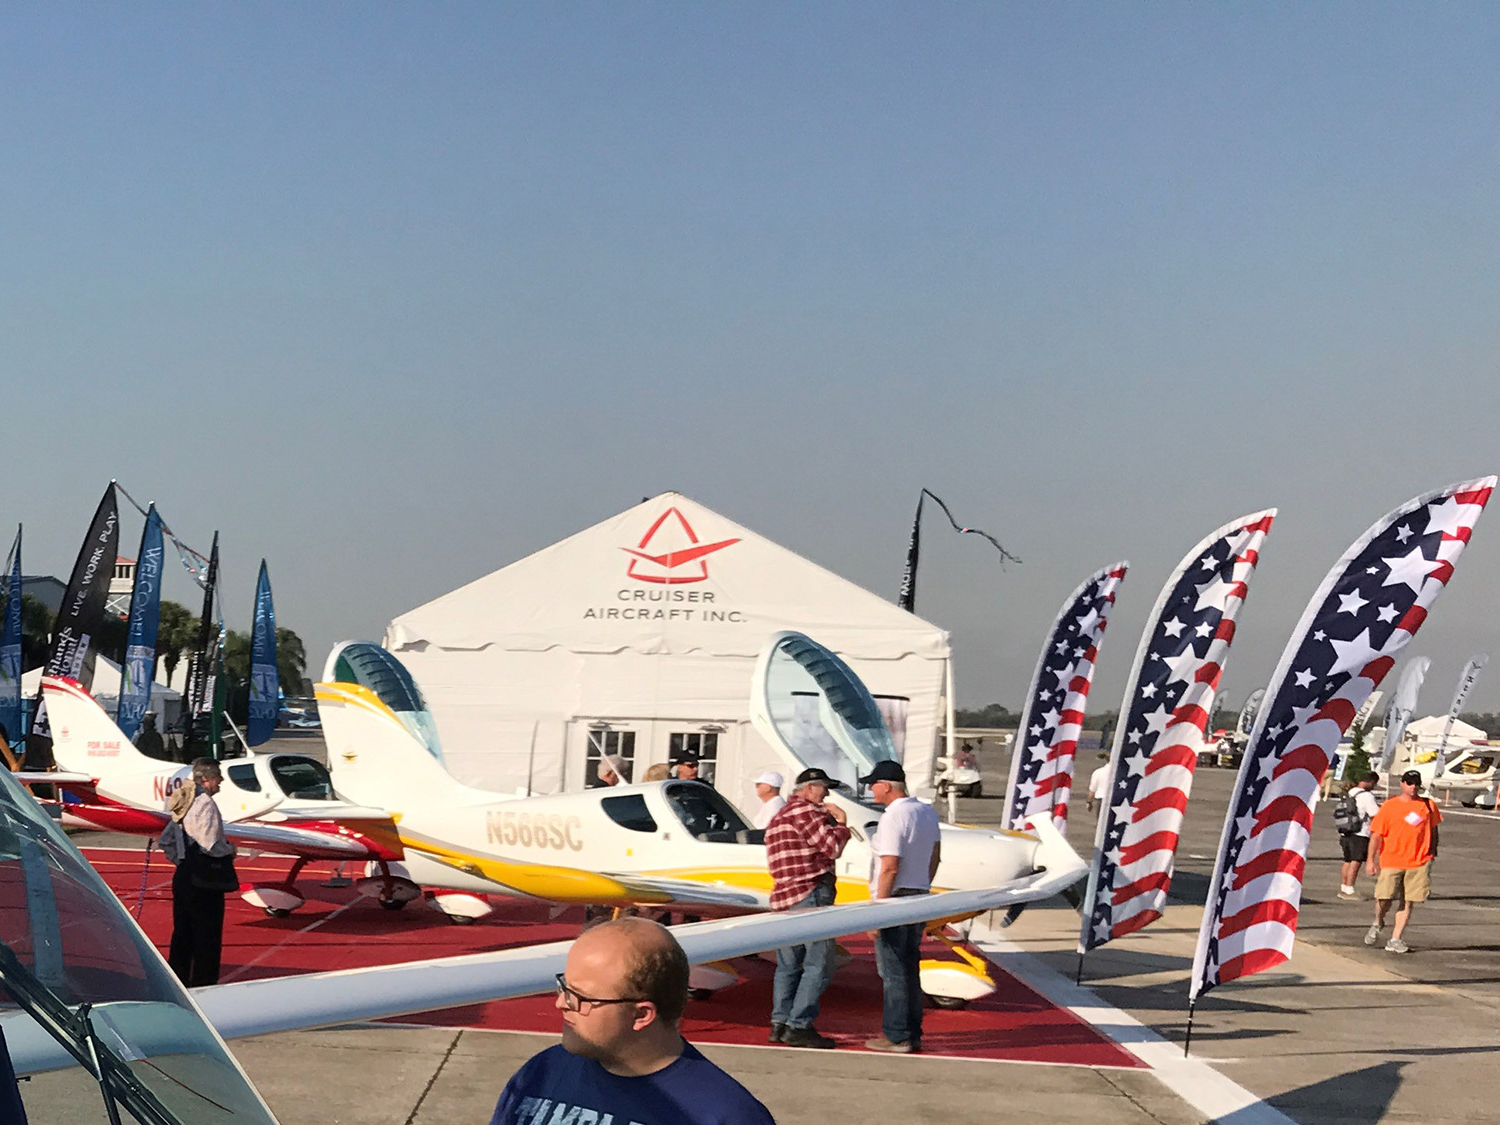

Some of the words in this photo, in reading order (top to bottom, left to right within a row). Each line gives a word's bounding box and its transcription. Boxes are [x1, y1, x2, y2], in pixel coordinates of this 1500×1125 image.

[617, 589, 715, 603] CRUISER
[583, 608, 695, 621] AIRCRAFT
[702, 610, 748, 623] INC.
[103, 741, 121, 750] SALE
[486, 810, 584, 852] N566SC
